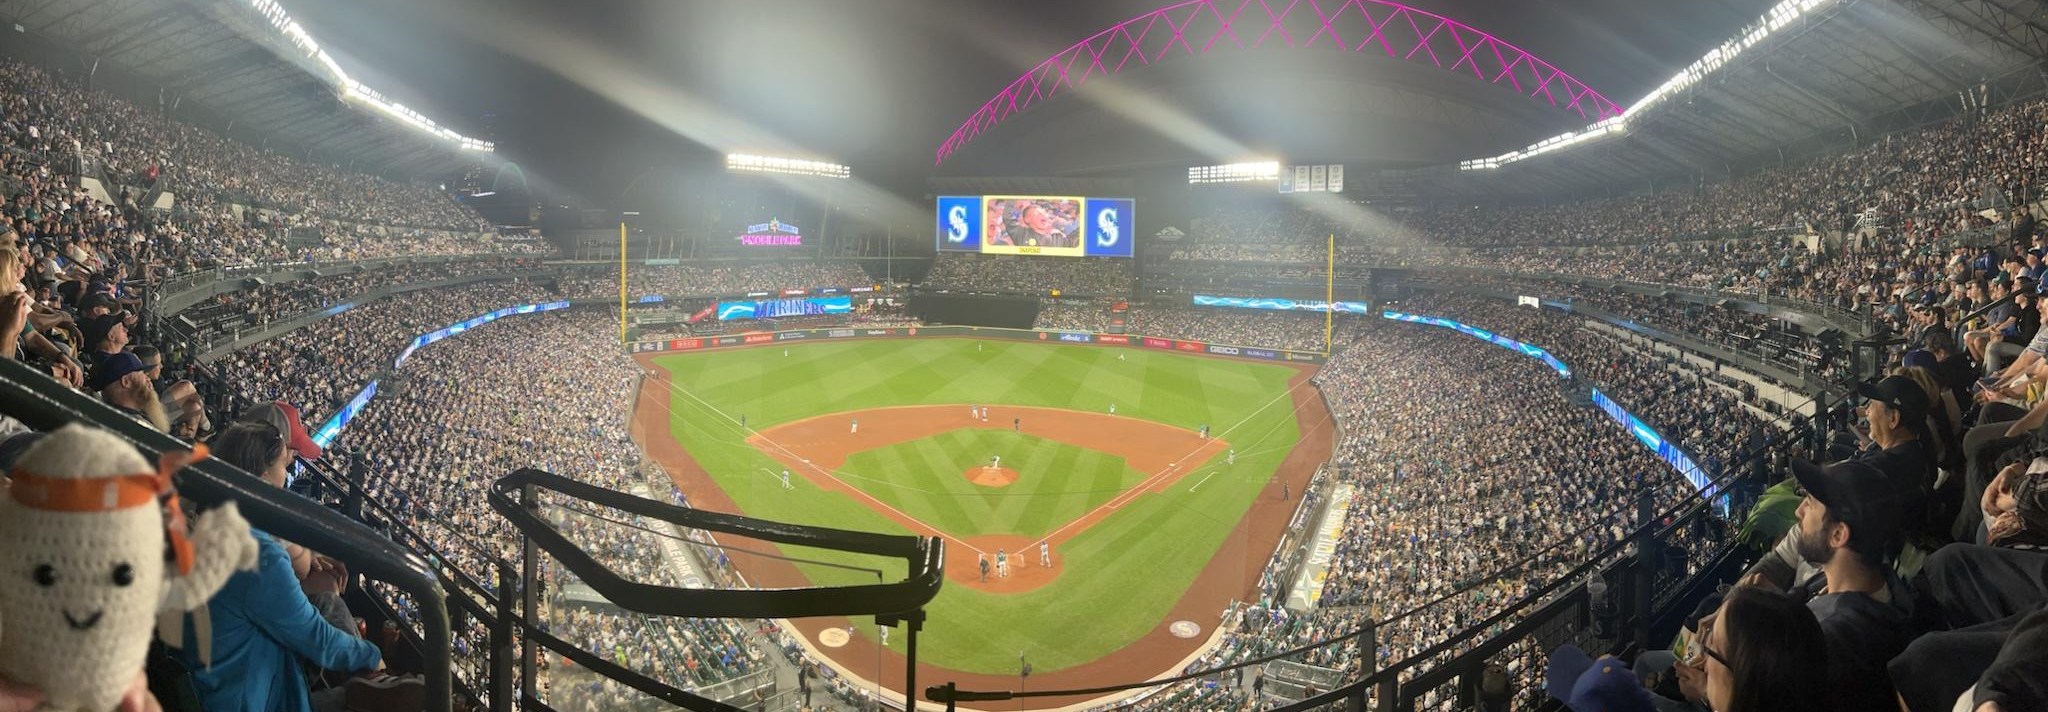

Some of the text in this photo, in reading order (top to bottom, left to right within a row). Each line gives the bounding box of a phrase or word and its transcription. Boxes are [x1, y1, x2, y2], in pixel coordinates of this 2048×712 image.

[947, 204, 969, 244] S
[1096, 207, 1119, 247] S
[754, 299, 826, 317] MARINERS
[1210, 345, 1239, 355] GEICO
[673, 555, 694, 577] PARK
